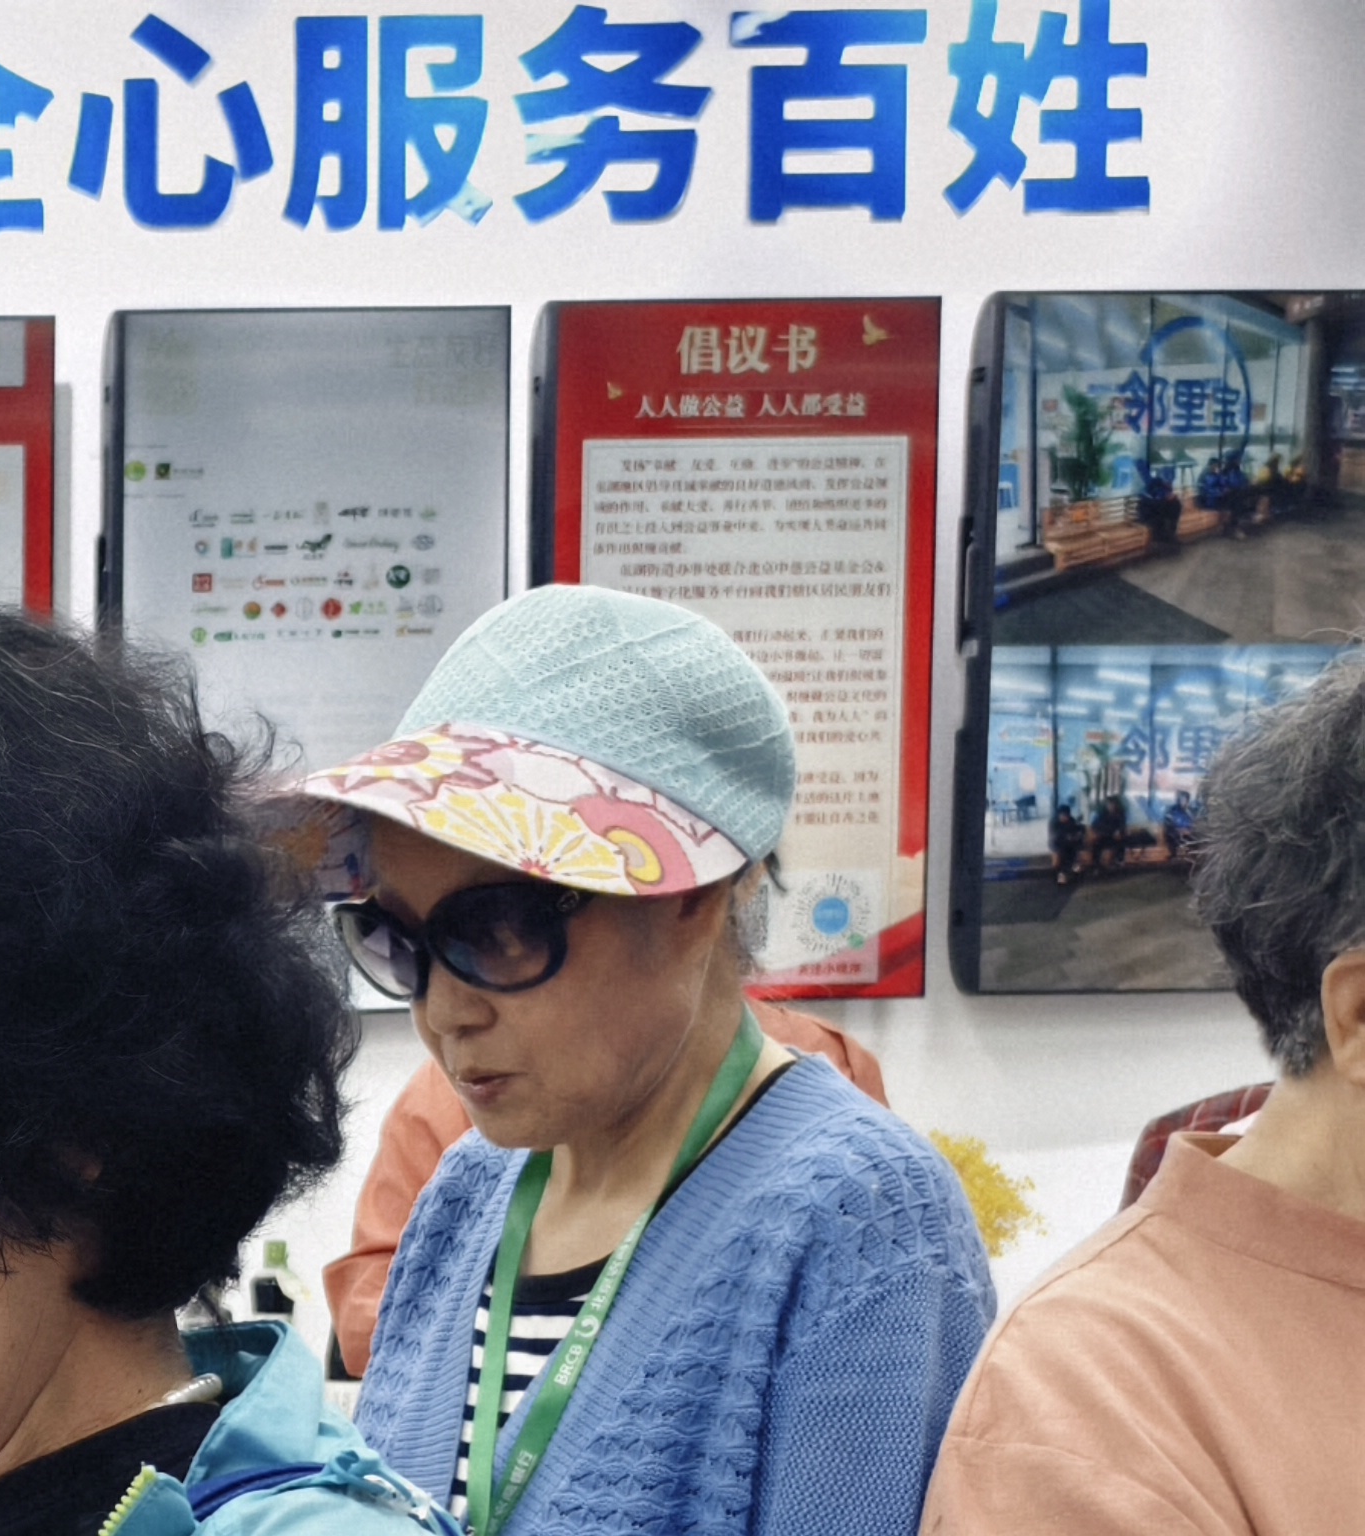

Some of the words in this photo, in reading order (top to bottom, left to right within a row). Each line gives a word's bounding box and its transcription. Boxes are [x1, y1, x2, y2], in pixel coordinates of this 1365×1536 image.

[675, 322, 819, 375] 倡议书
[634, 394, 746, 419] 人人做公益
[756, 391, 867, 418] 人人都受益
[1116, 369, 1241, 434] 邻里宝
[1114, 725, 1224, 776] 邻里
[554, 1343, 584, 1387] BRCB
